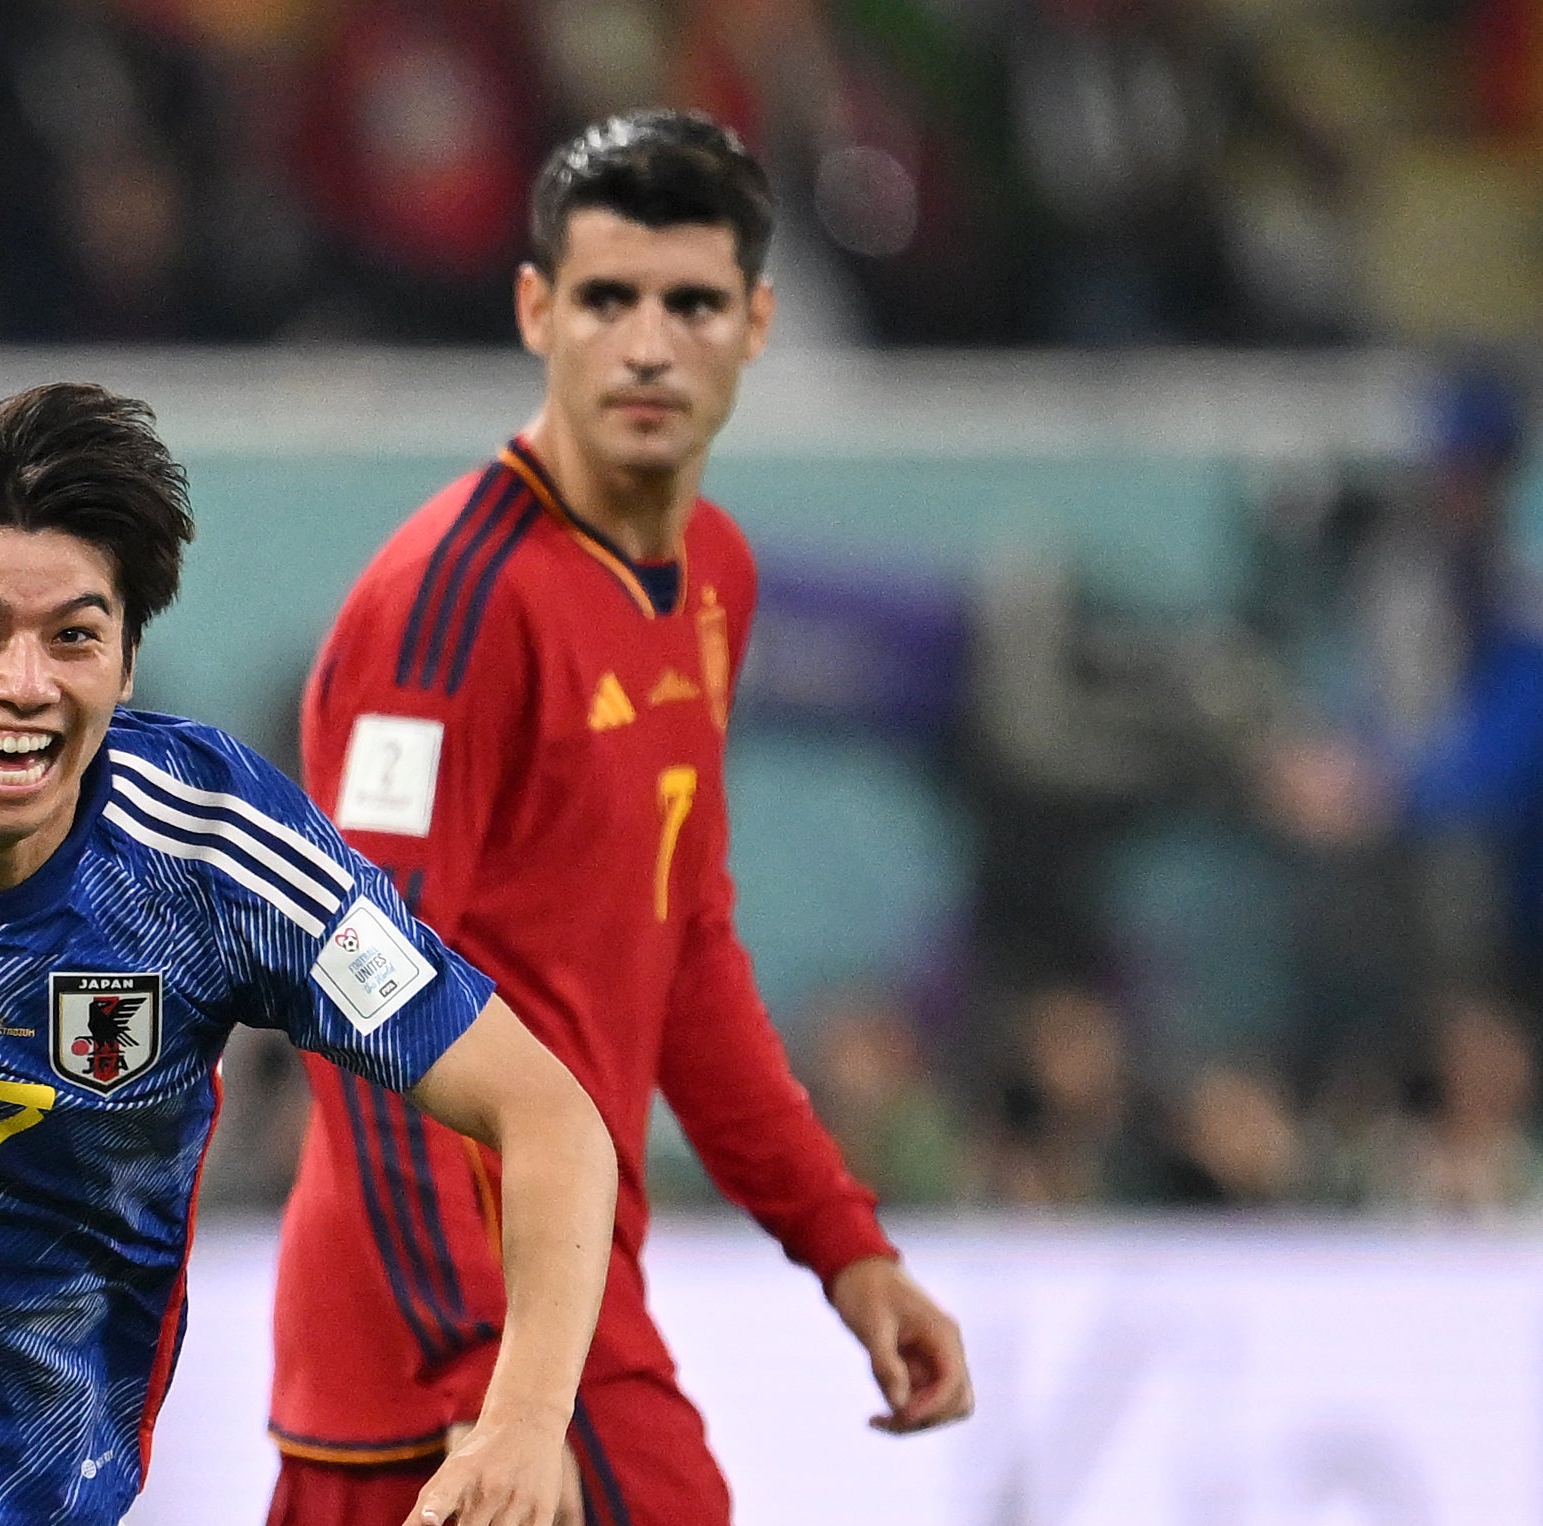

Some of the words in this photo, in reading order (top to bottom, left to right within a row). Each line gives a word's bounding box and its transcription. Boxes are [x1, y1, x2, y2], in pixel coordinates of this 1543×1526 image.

[655, 766, 698, 922] 7
[354, 953, 387, 983] UNITES
[79, 979, 134, 989] JAPAN
